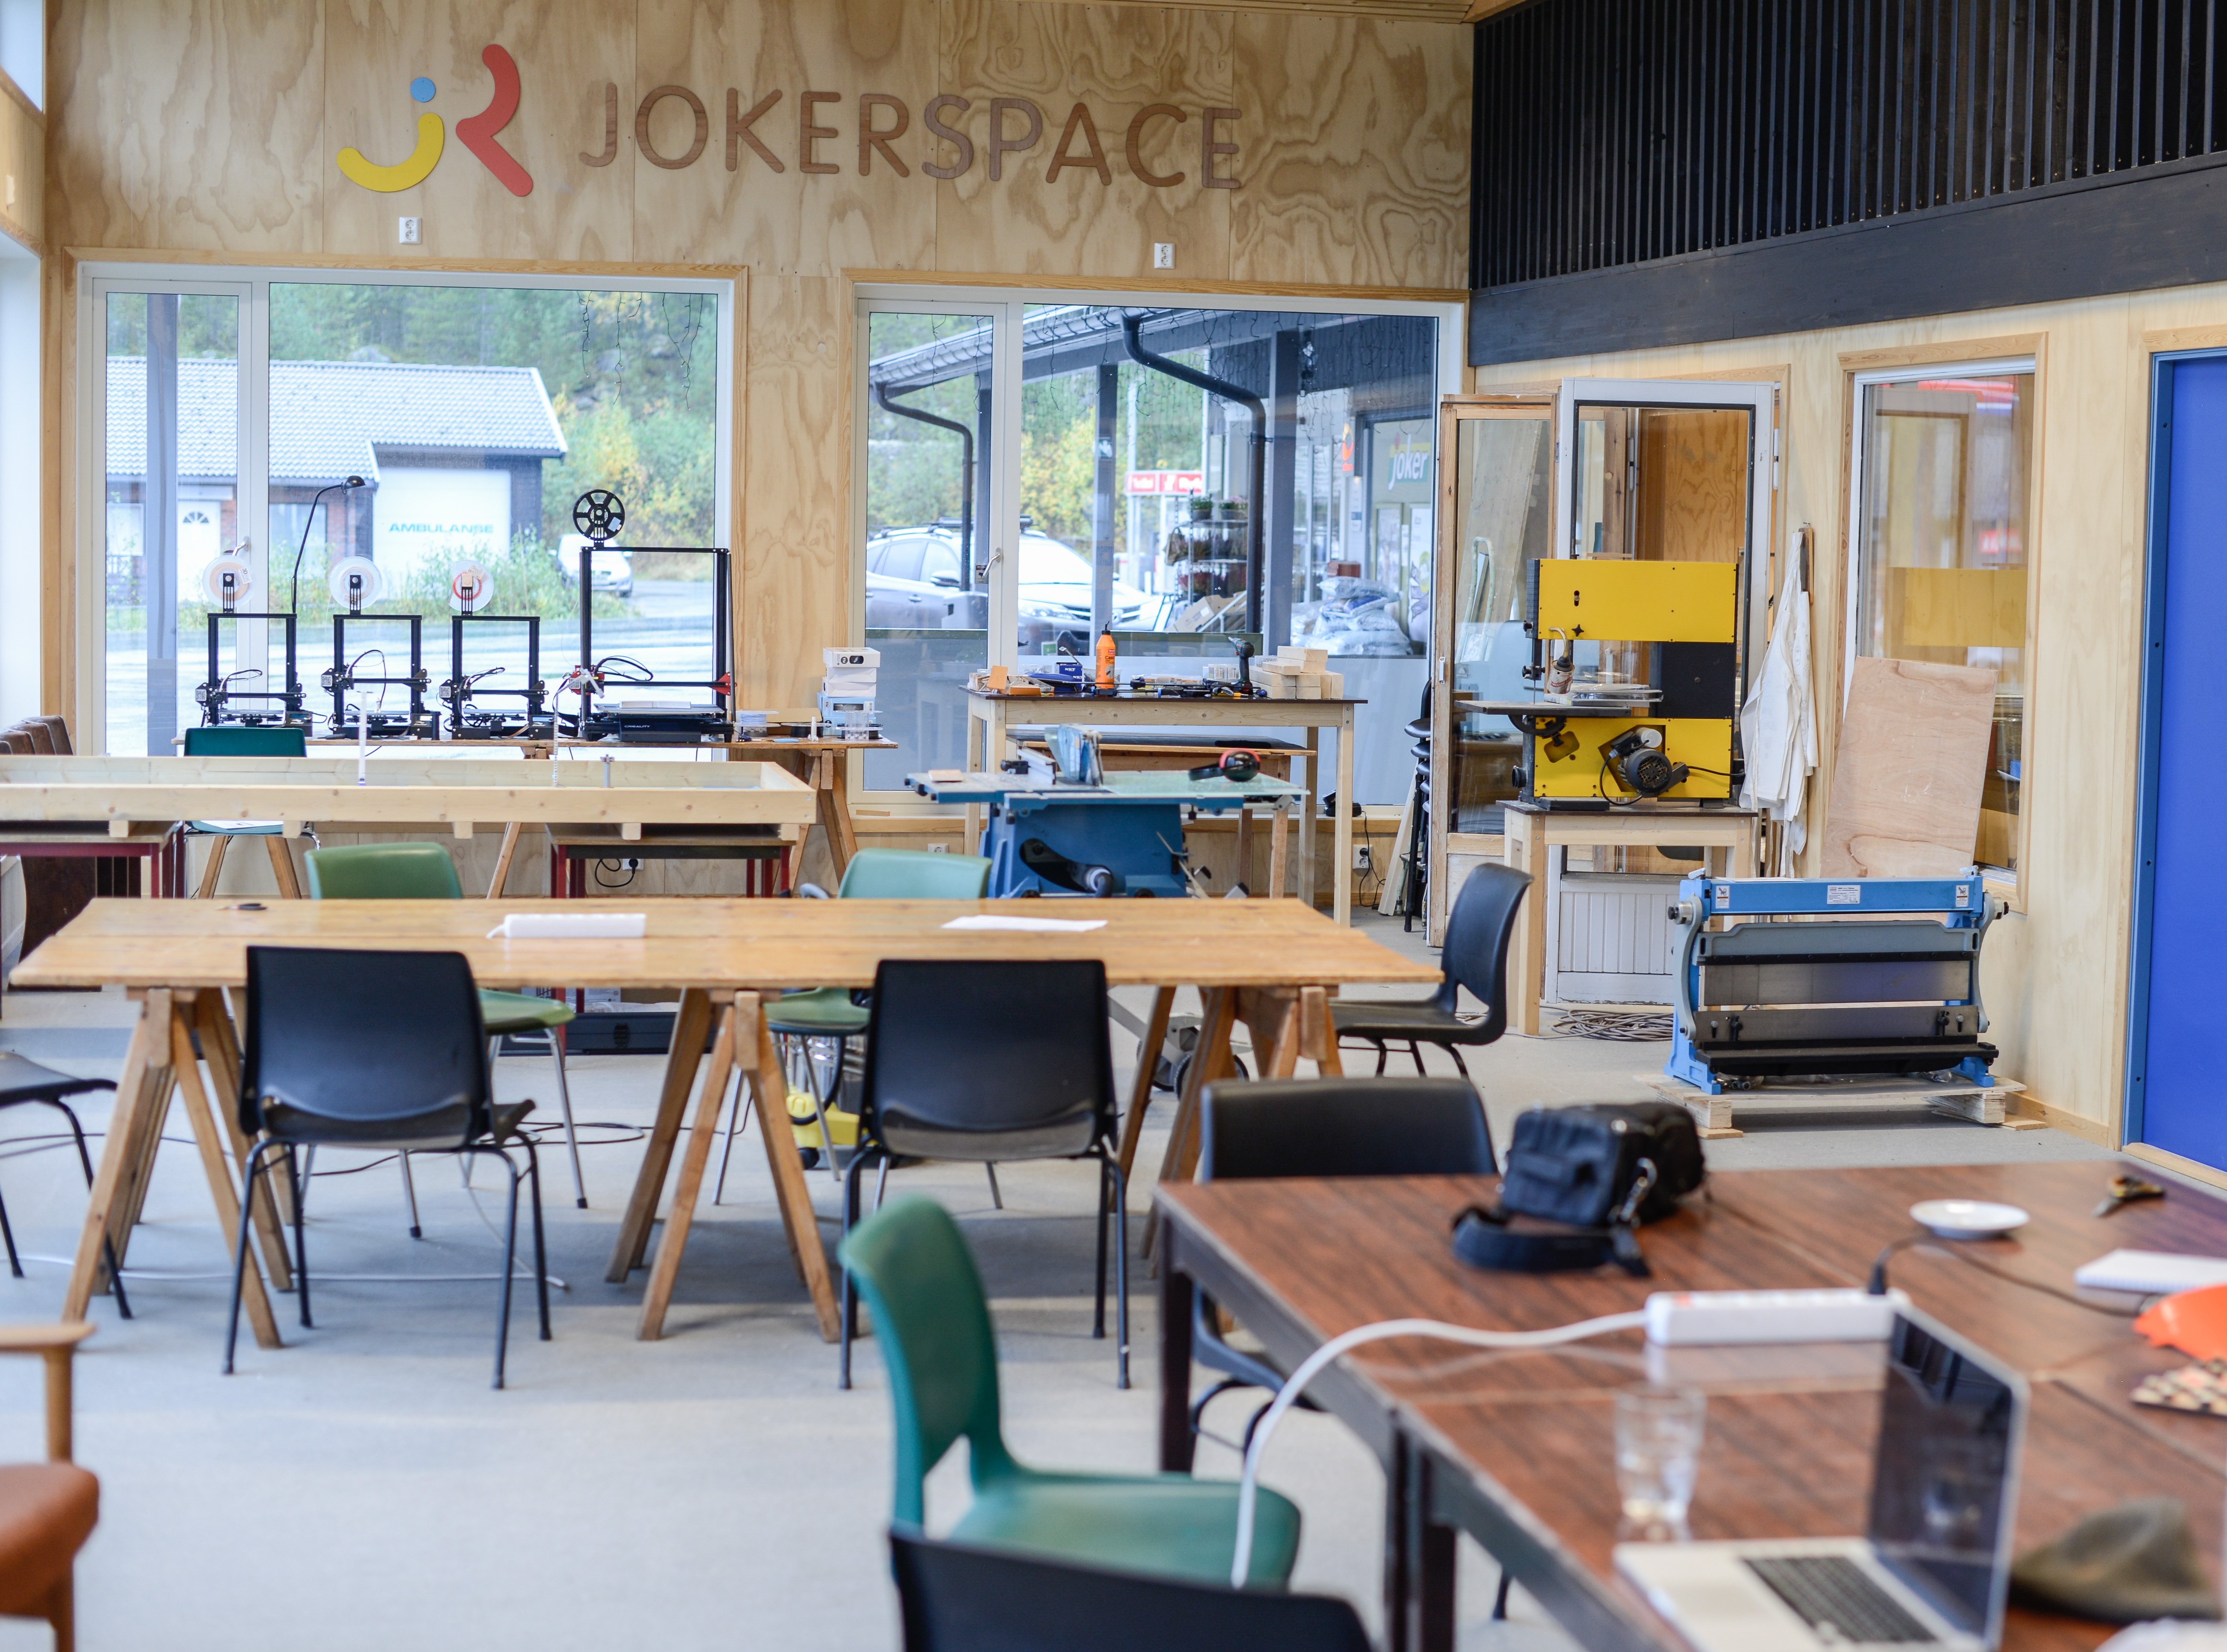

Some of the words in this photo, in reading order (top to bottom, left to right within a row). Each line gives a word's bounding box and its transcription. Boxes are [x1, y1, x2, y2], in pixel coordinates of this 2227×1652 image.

[578, 82, 1242, 189] JOKERSPACE
[1388, 433, 1428, 491] joker
[389, 523, 494, 533] AMBULANSE
